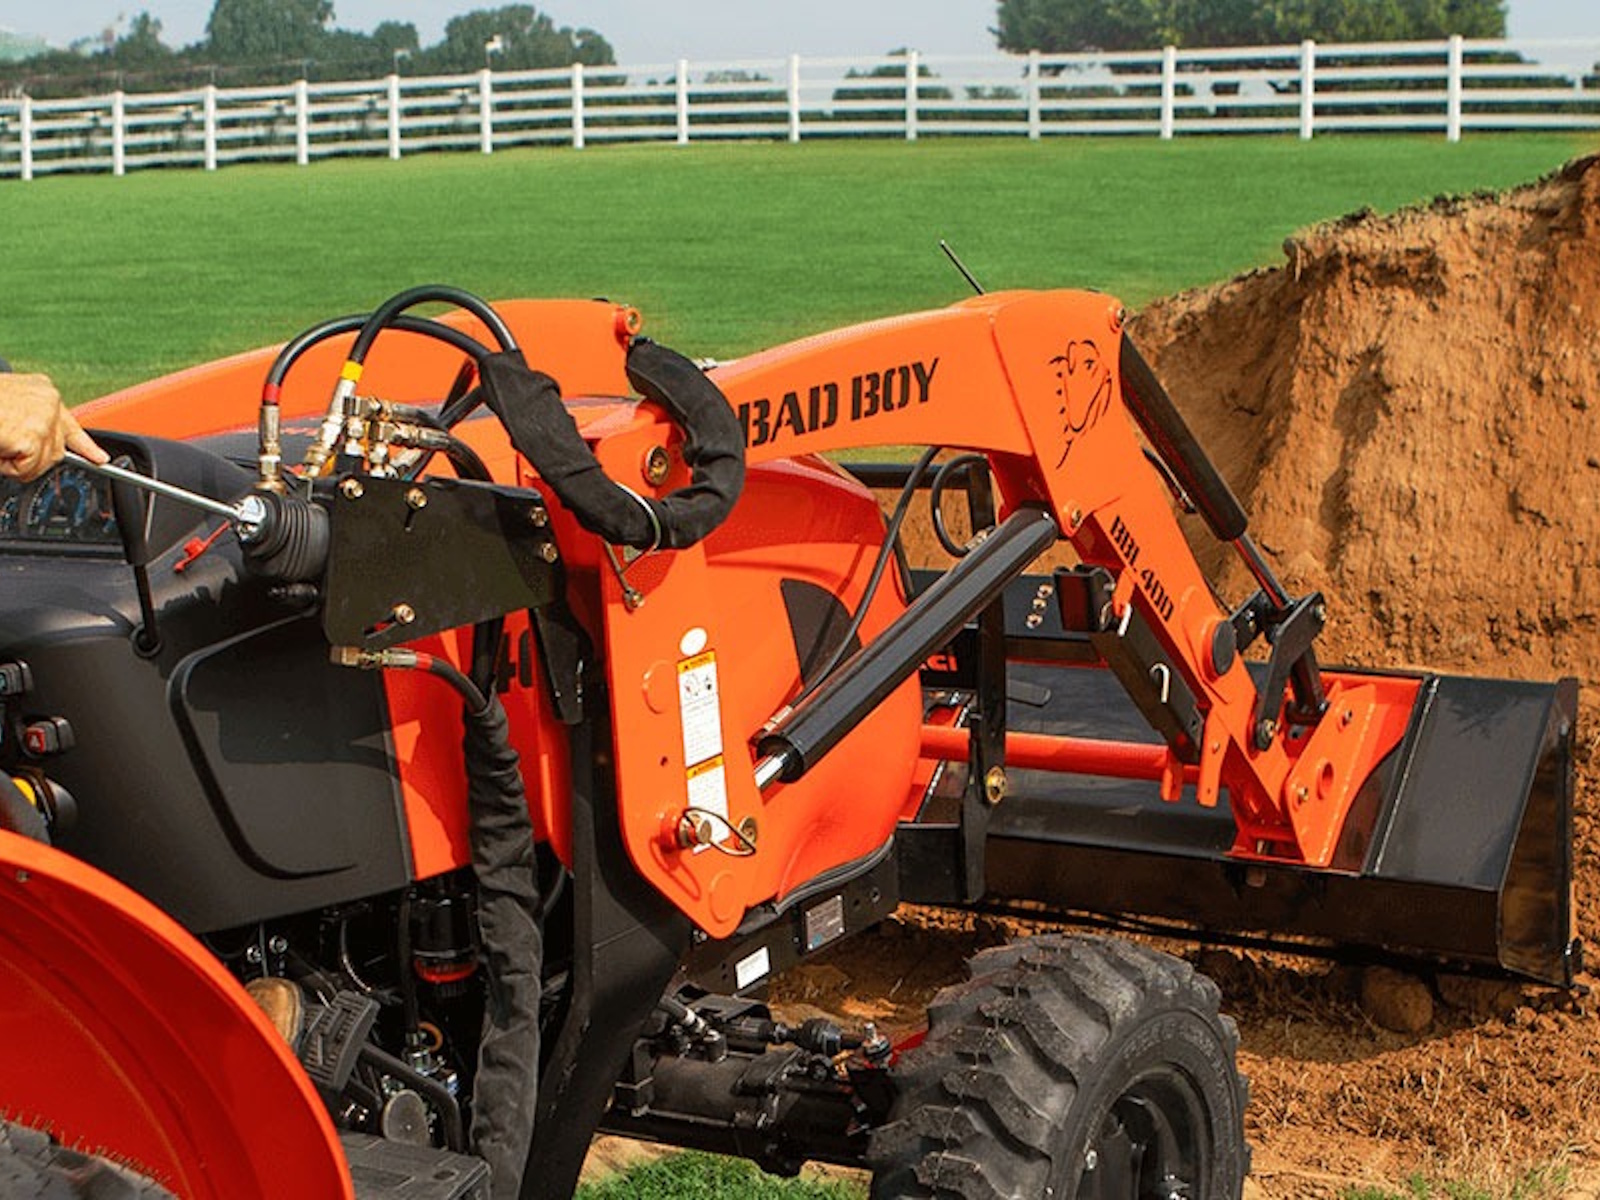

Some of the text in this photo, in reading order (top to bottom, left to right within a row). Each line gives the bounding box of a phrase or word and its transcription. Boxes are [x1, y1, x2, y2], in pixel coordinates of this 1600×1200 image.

[738, 357, 939, 448] BAD BOY
[1110, 515, 1174, 622] BBL 400
